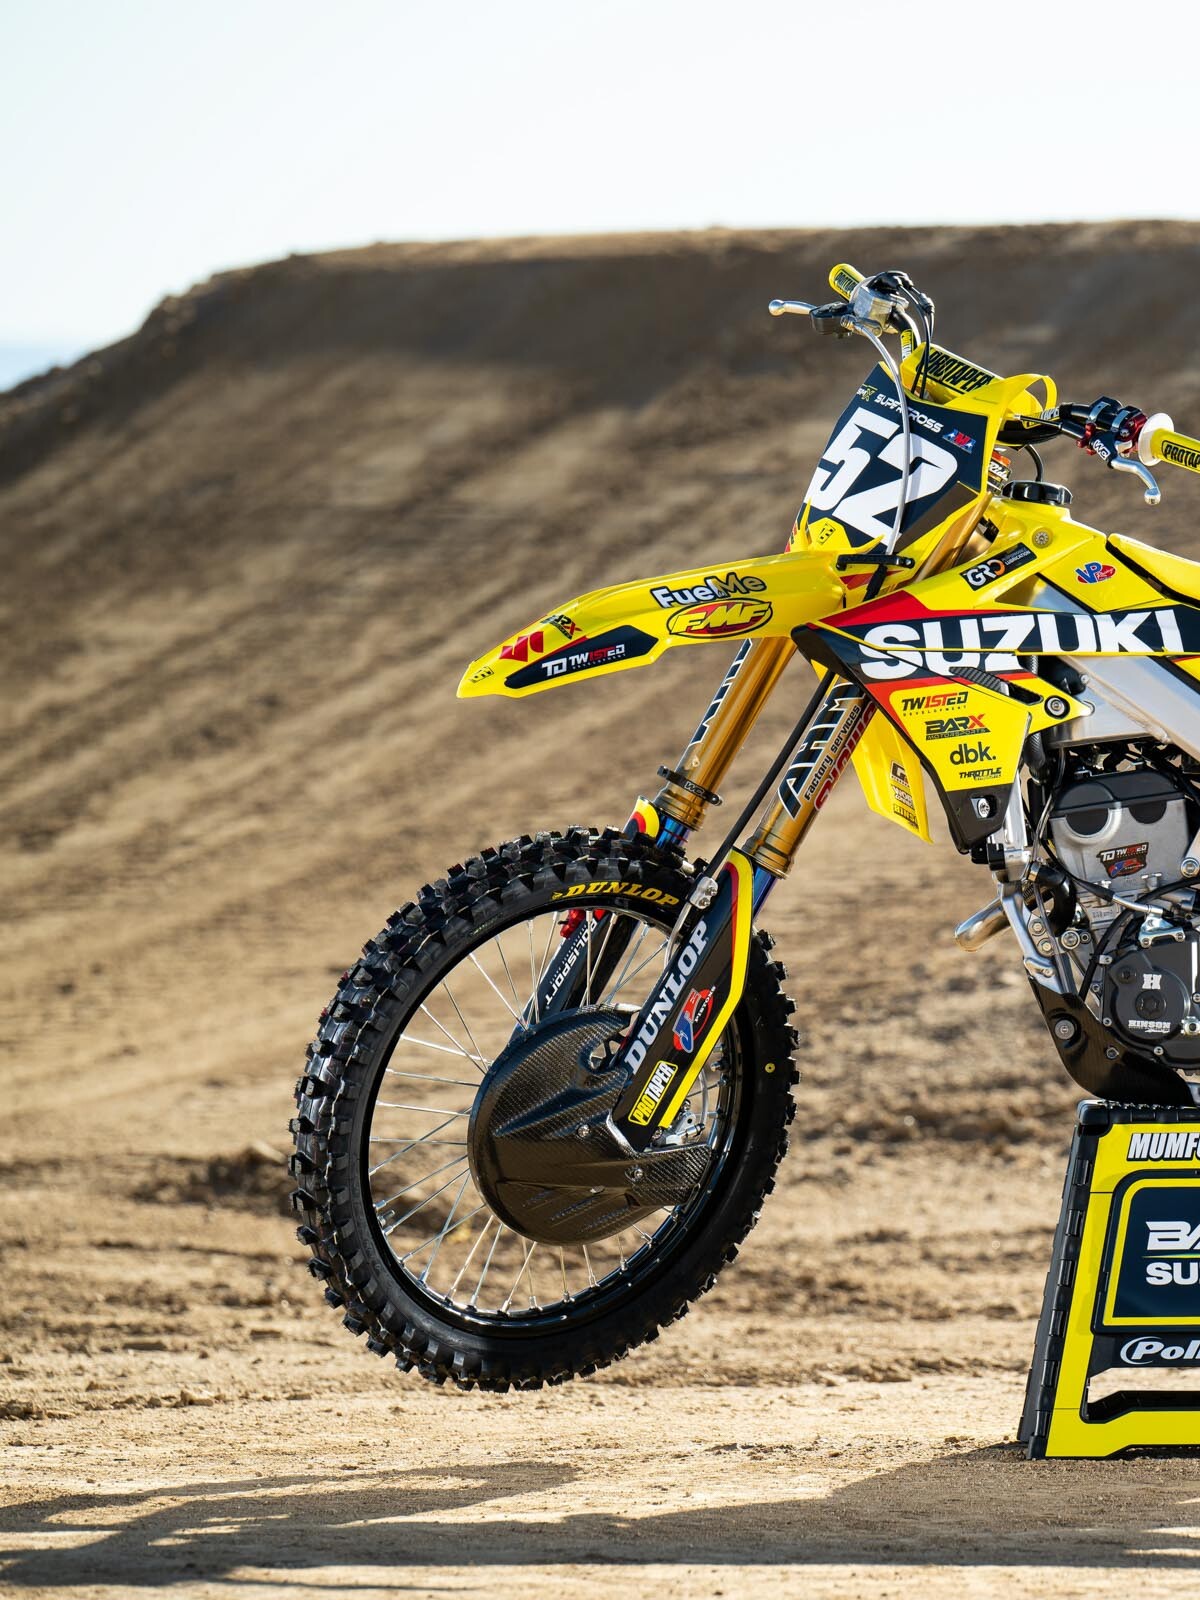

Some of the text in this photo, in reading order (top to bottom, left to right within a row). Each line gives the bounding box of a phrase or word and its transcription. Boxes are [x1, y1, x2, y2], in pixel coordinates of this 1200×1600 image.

[943, 428, 976, 453] AMA
[803, 407, 958, 547] 52
[966, 560, 1006, 586] GRO
[1075, 562, 1102, 584] VP
[669, 601, 772, 635] FMF
[860, 608, 1184, 679] SUZUKI
[902, 692, 969, 711] TWISTED
[831, 705, 862, 754] services
[925, 714, 985, 734] BARX
[926, 728, 987, 740] MOTORSPORTS
[950, 742, 997, 765] dbk.
[959, 767, 1002, 781] THROTTLE
[562, 882, 680, 906] DUNLOP
[624, 920, 708, 1075] DUNLOP
[1128, 1020, 1171, 1030] HINSON
[633, 1062, 677, 1124] PROTAPER
